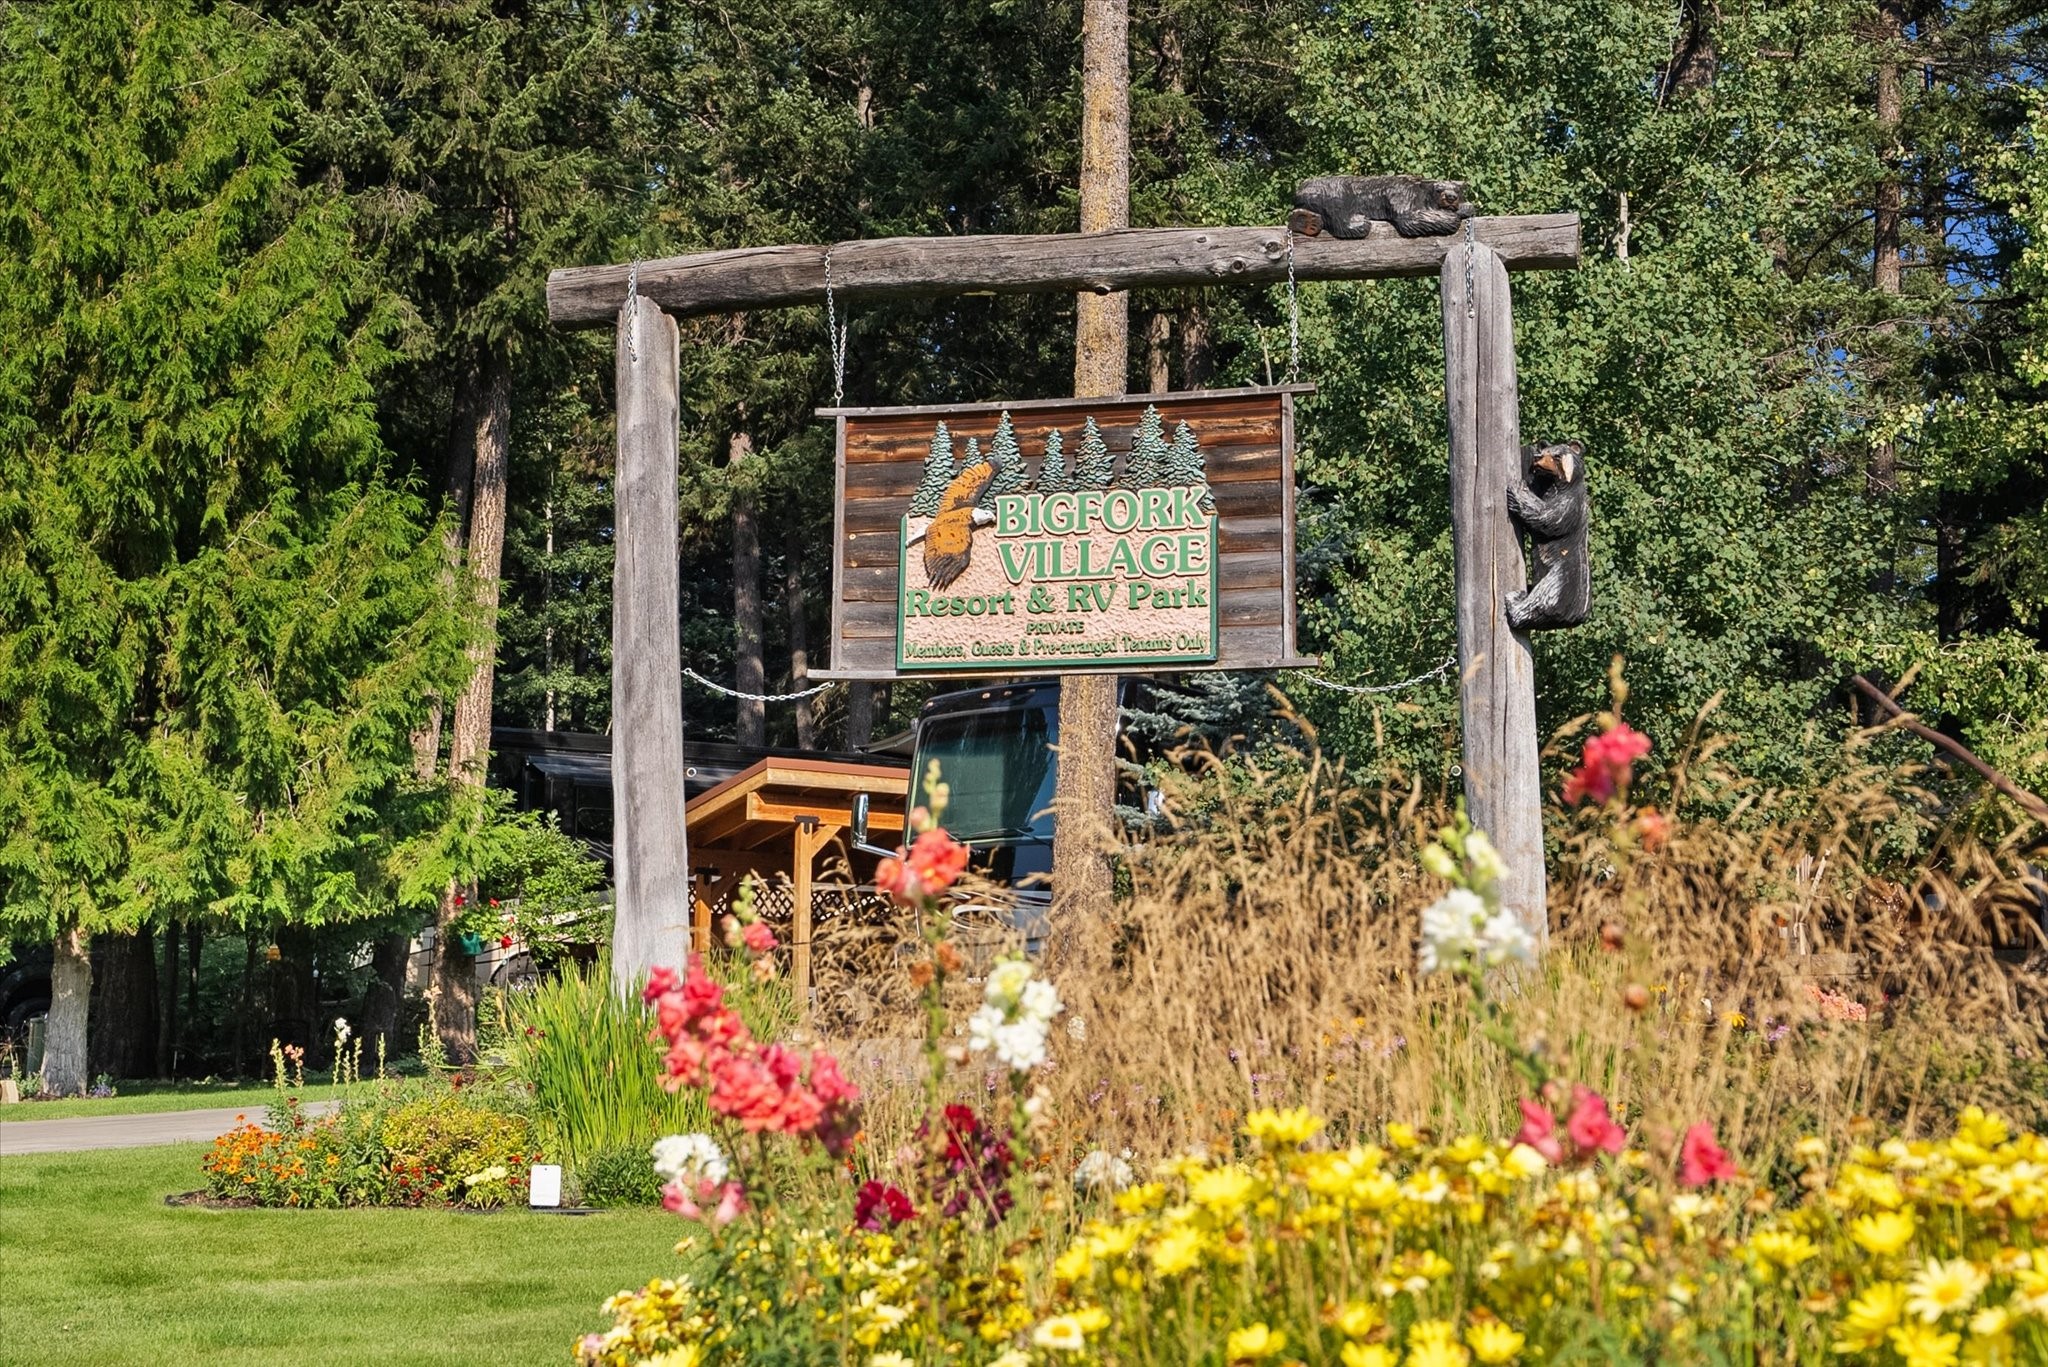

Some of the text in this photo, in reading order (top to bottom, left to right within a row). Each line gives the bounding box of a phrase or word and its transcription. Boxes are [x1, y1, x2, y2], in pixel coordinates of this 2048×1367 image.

[996, 486, 1207, 535] BIGFORK
[998, 535, 1209, 583] VILLAGE
[906, 579, 1208, 617] Resort & RV Park
[905, 642, 967, 659] Members,
[971, 640, 1015, 657] Guests
[1018, 638, 1031, 656] &
[1033, 637, 1118, 656] Pre-arranged
[1176, 631, 1206, 653] Only
[1026, 620, 1085, 635] PRIVATE
